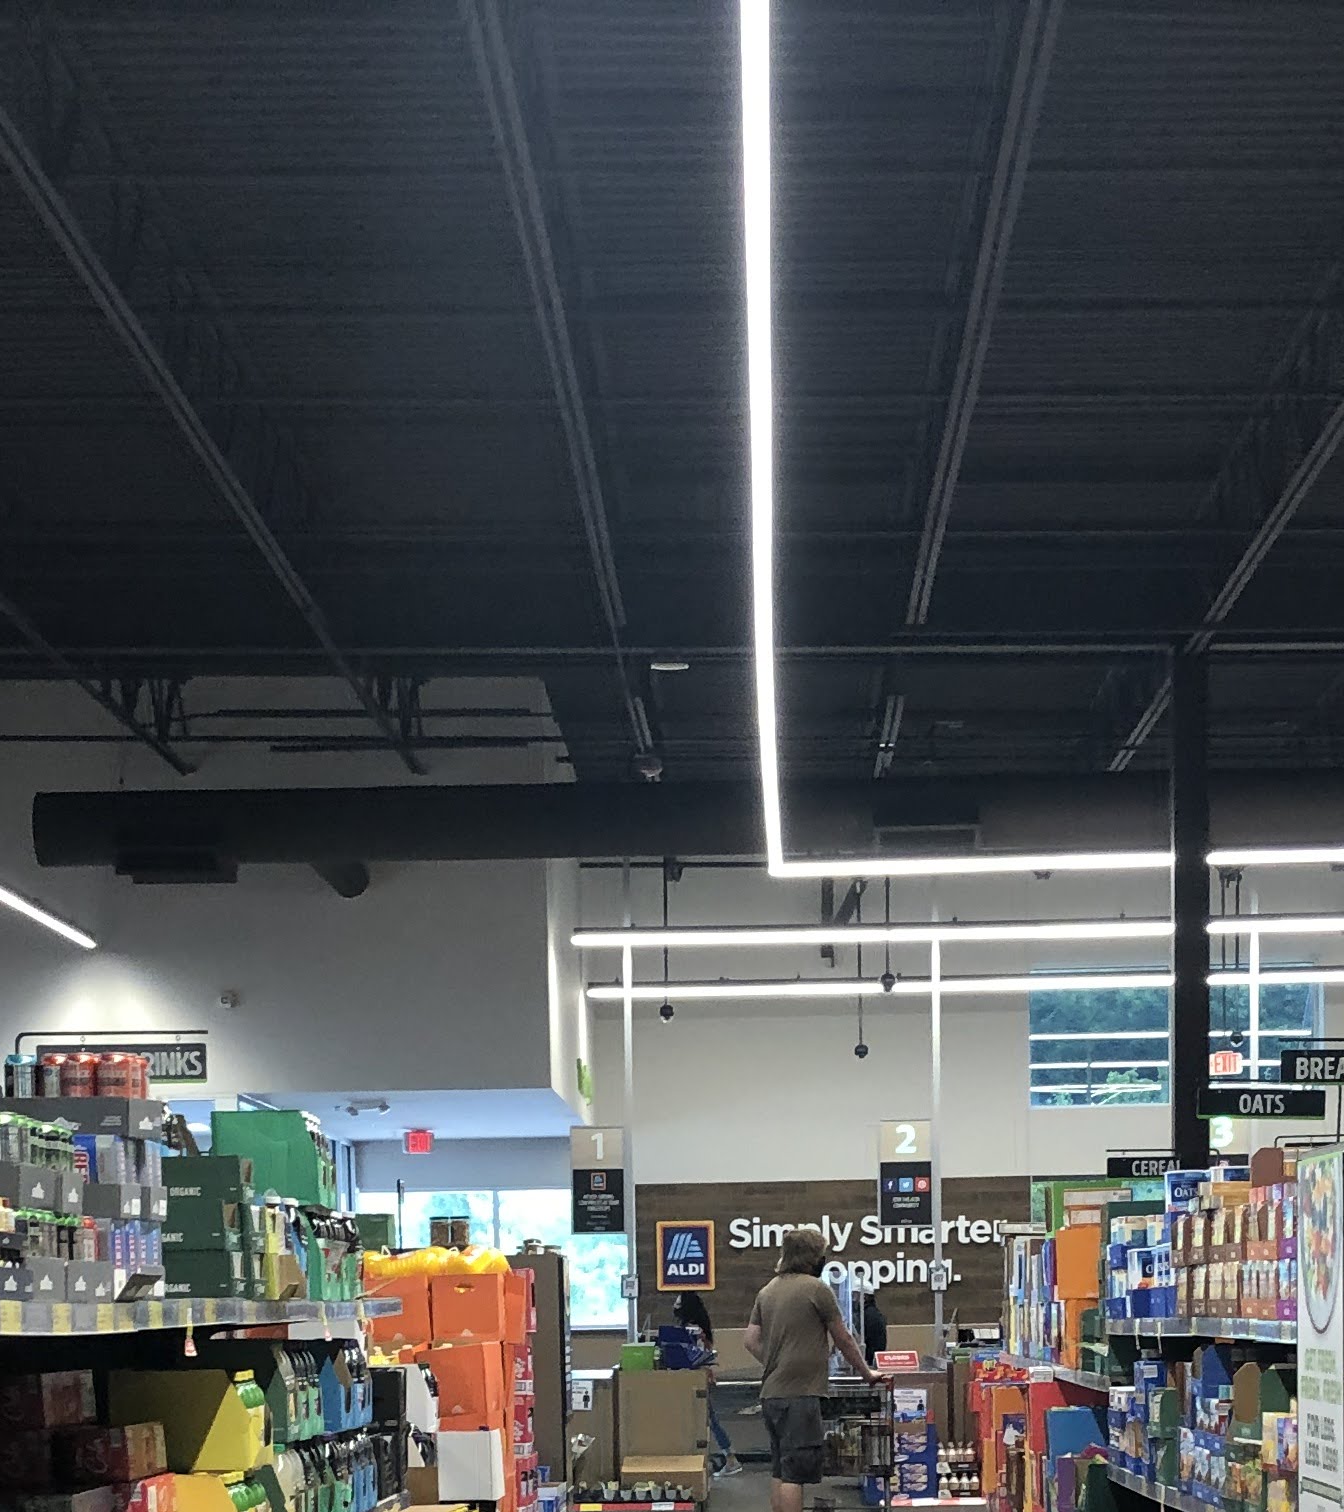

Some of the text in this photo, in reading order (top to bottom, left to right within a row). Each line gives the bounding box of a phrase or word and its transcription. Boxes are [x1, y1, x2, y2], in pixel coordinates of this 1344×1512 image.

[141, 1051, 203, 1077] RINKS
[1214, 1054, 1238, 1074] EXIT
[1238, 1093, 1286, 1114] OATS
[895, 1124, 917, 1154] 2
[1210, 1116, 1234, 1148] 3
[591, 1132, 604, 1160] 1
[728, 1214, 854, 1251] Simly
[667, 1262, 706, 1277] ALDI
